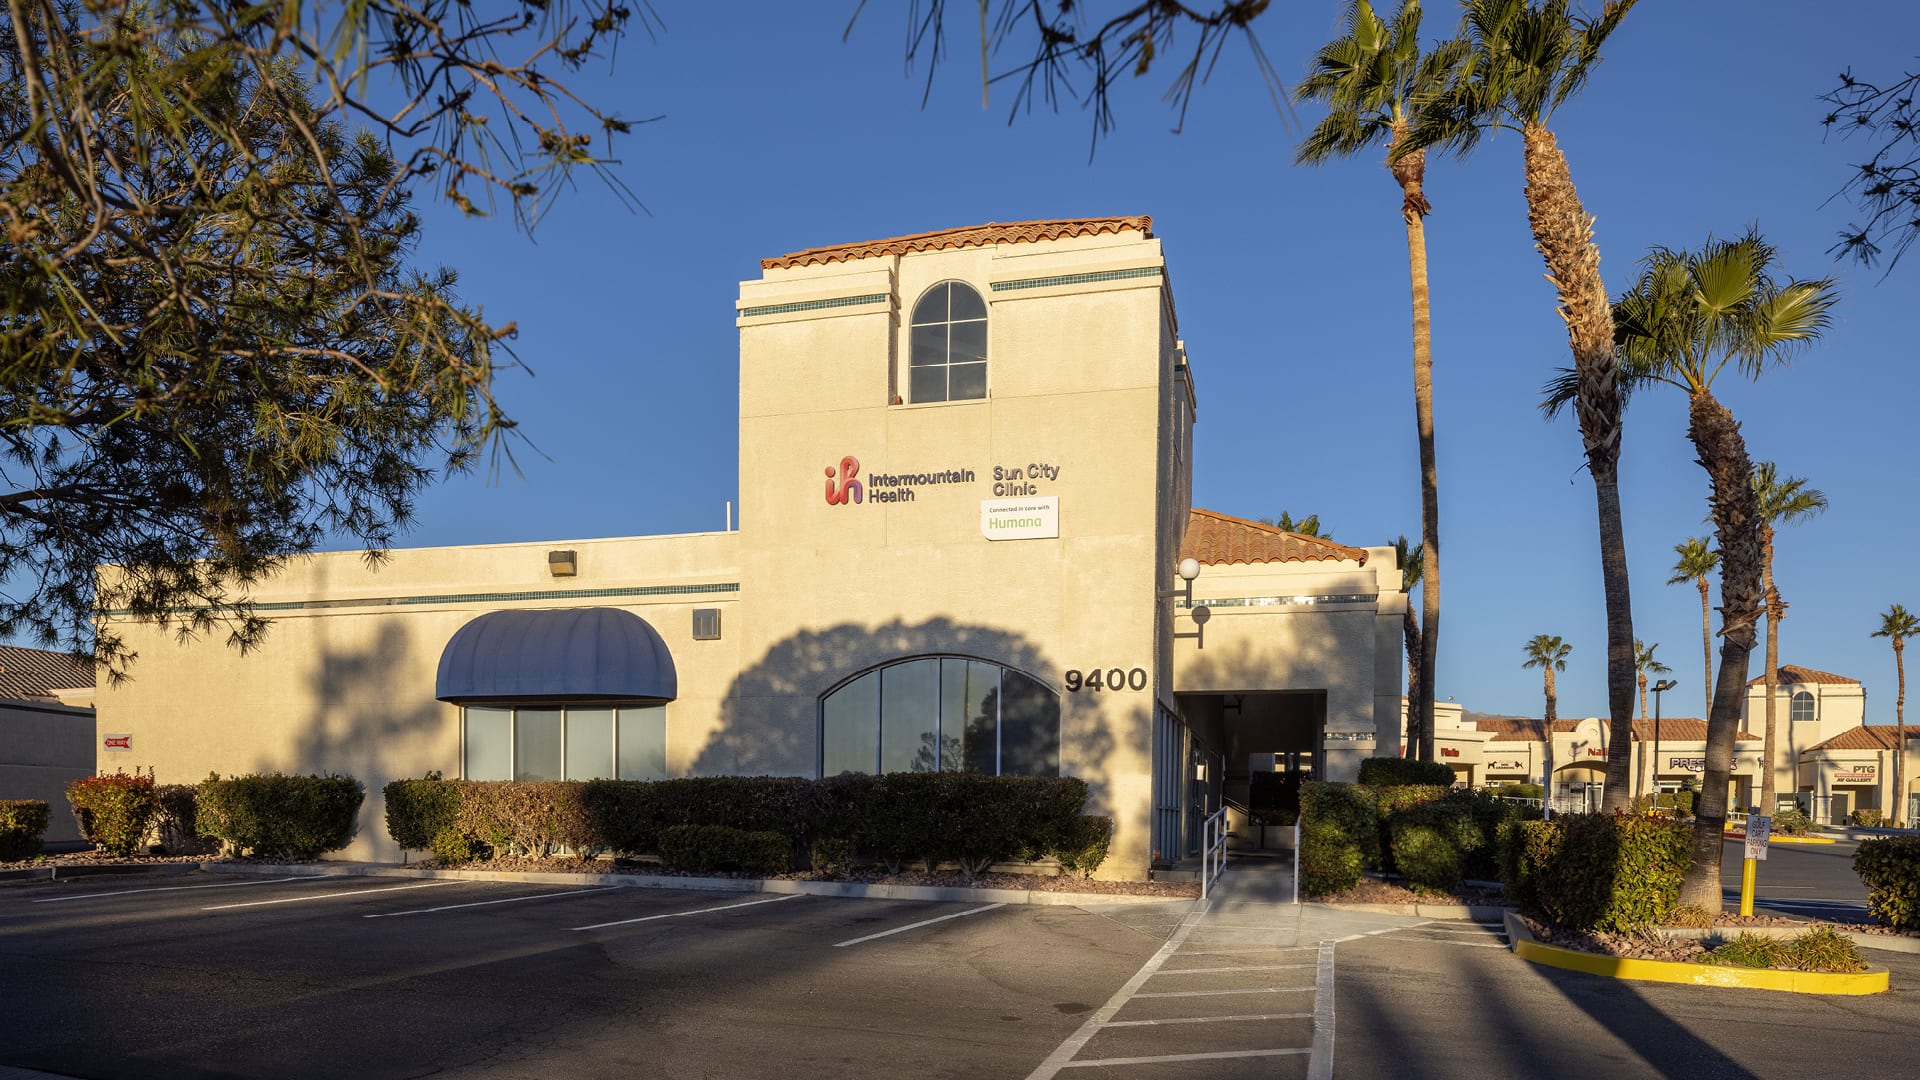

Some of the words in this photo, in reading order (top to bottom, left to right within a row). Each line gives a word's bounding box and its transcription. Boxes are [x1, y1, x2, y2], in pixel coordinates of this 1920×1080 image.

[869, 468, 975, 488] Intermountain
[992, 465, 1023, 481] Sun
[1027, 463, 1060, 481] City
[869, 488, 915, 504] Health
[992, 481, 1037, 497] Clinic
[989, 517, 1042, 529] Humana
[1065, 667, 1147, 692] 9400
[1752, 820, 1766, 830] GOLF
[1752, 829, 1764, 838] CART
[1746, 838, 1767, 848] PARKING
[1750, 847, 1762, 855] ONLY
